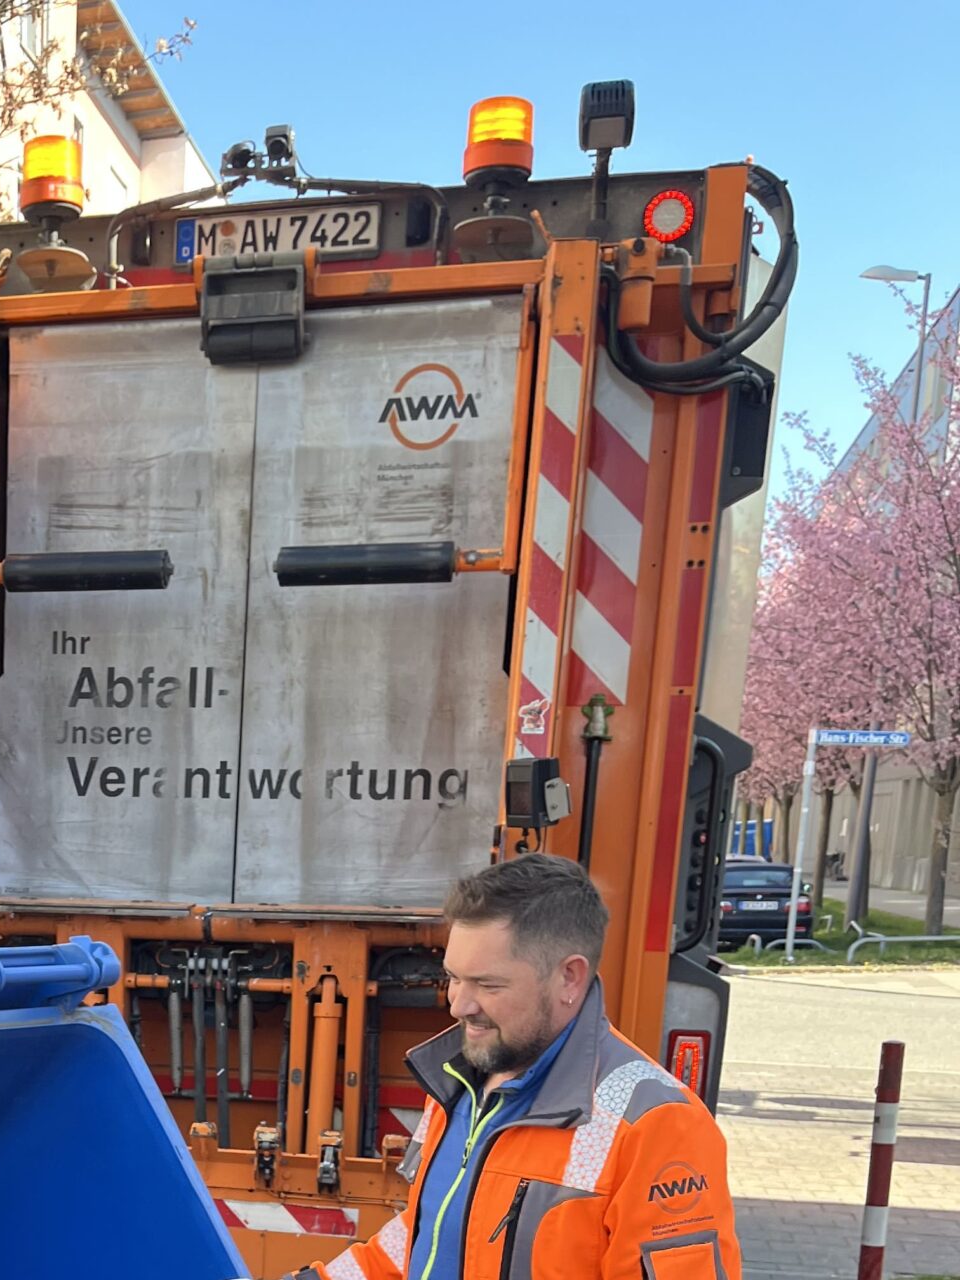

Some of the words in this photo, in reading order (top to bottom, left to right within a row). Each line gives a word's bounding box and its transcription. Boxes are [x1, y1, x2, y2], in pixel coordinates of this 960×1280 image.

[197, 223, 217, 256] M
[240, 217, 282, 254] AW
[290, 210, 372, 250] 7422
[378, 393, 479, 423] AWM
[52, 631, 90, 655] Ihr
[68, 667, 229, 708] Abfall-
[648, 1175, 708, 1202] AWM
